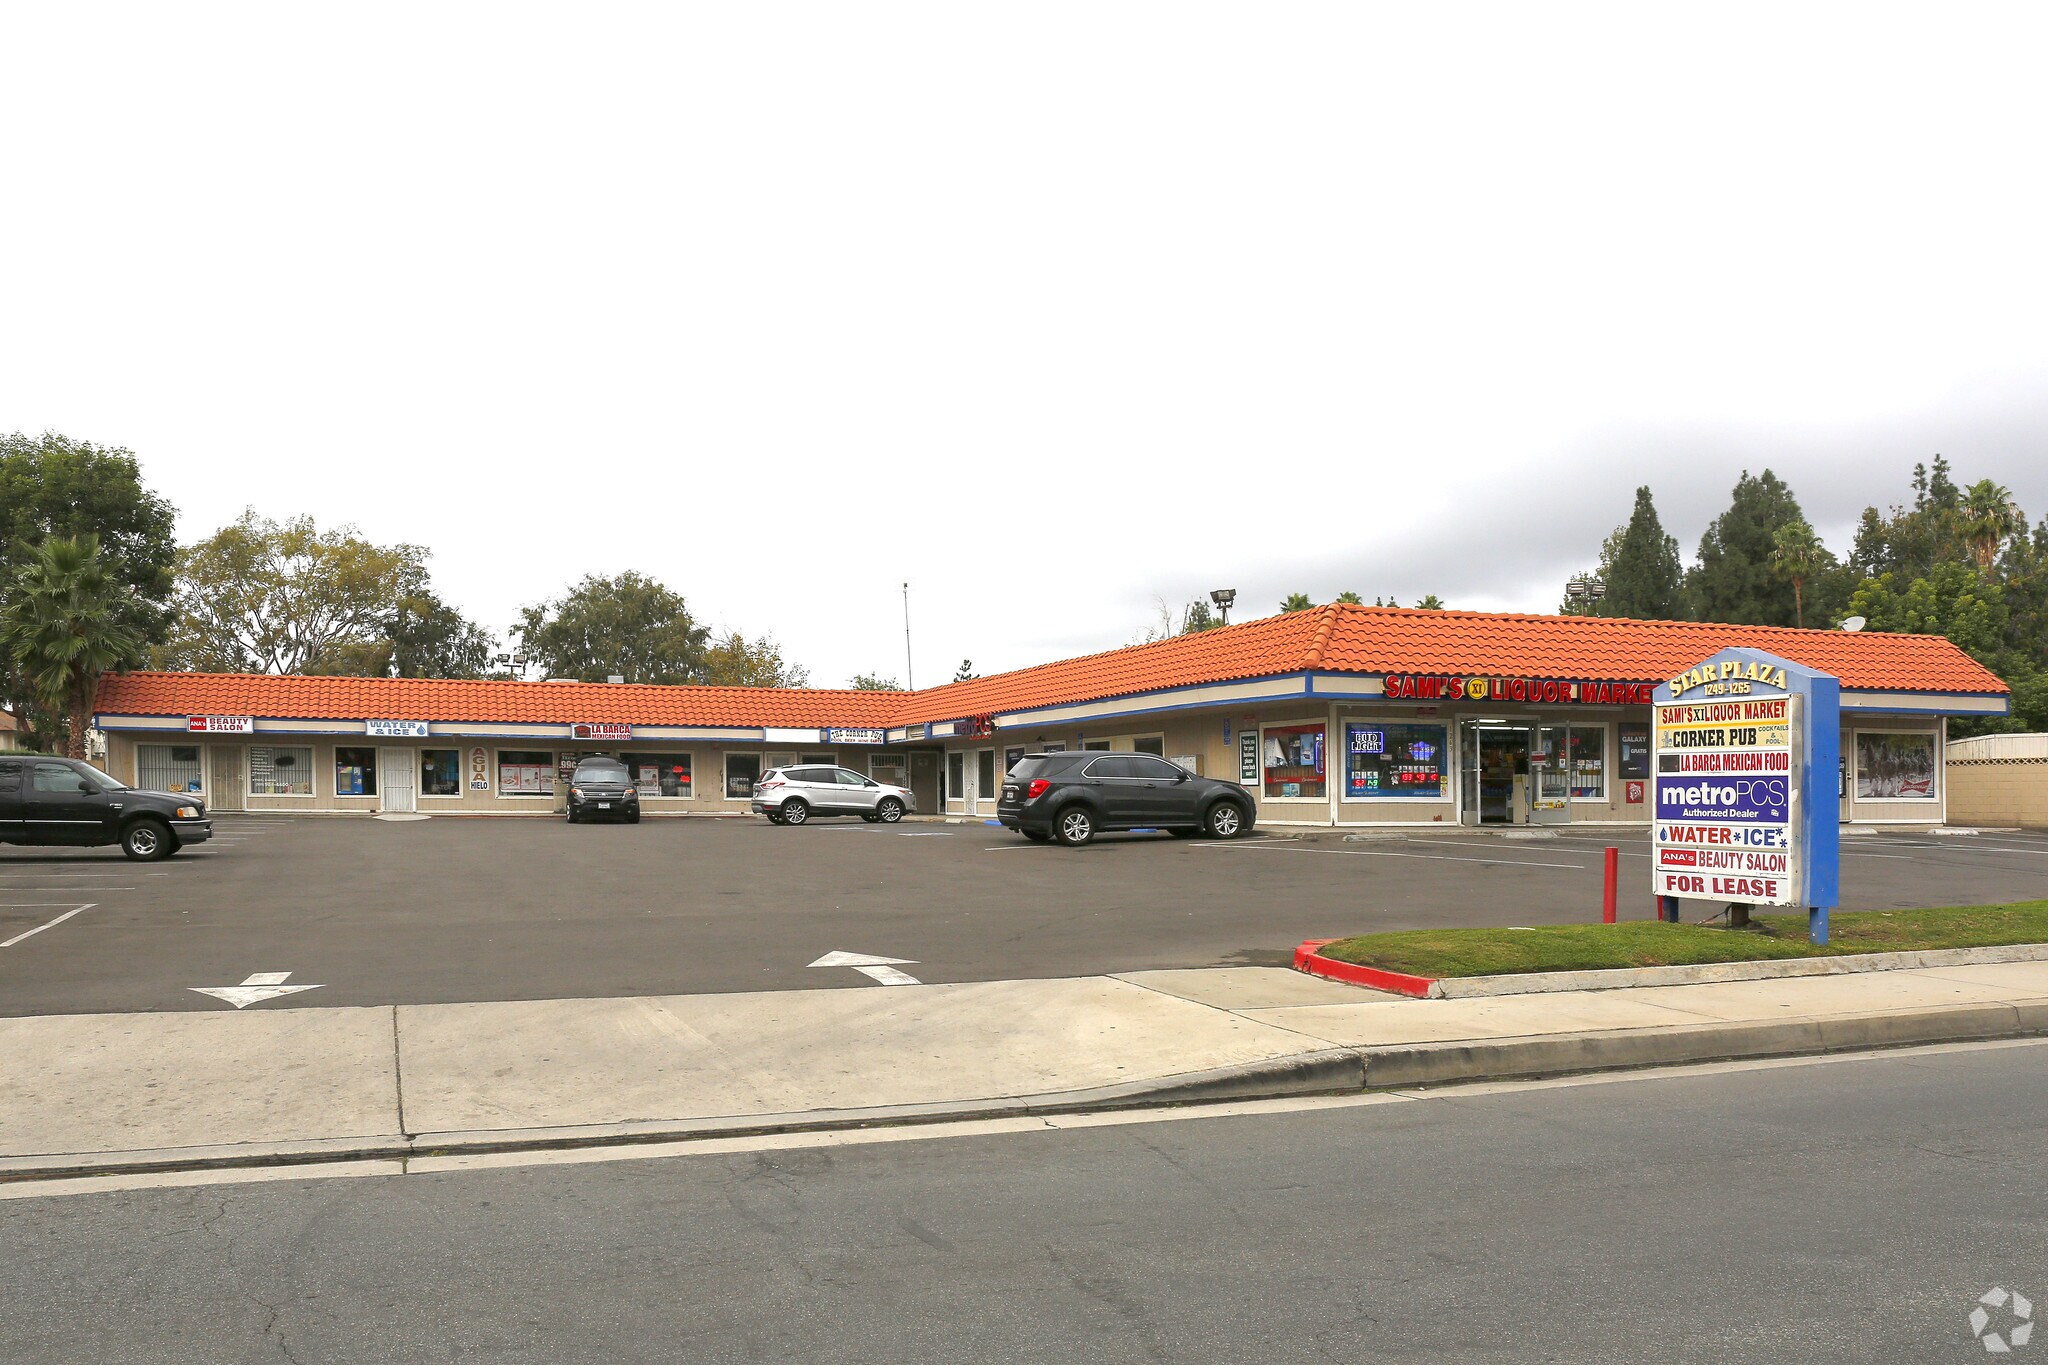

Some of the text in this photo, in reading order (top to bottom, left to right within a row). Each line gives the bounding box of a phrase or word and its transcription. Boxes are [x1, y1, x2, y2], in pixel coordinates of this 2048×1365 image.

[1386, 675, 1463, 700] SAMI'S
[1491, 678, 1572, 702] LIQUOR
[1669, 661, 1787, 698] STAR PLAZA
[1704, 682, 1751, 696] 1249-1265
[1662, 701, 1786, 724] SAMI'S XI LIQUOR MARKET
[370, 721, 416, 729] WATER
[592, 725, 631, 734] LA BARCA
[831, 730, 843, 738] THE
[1351, 742, 1382, 751] LIGHT
[1355, 733, 1378, 742] BUD
[1673, 728, 1757, 748] CORNER PUB
[472, 747, 486, 781] AGUA
[1681, 752, 1789, 772] LA BARCA MEXICAN FOOD
[470, 781, 488, 790] HIELO
[1682, 808, 1759, 818] Authorized Dealer
[1669, 826, 1775, 846] WATER ICE
[1662, 850, 1786, 872] ANA's BEAUTY SALON
[1666, 875, 1777, 897] FOR LEASE
